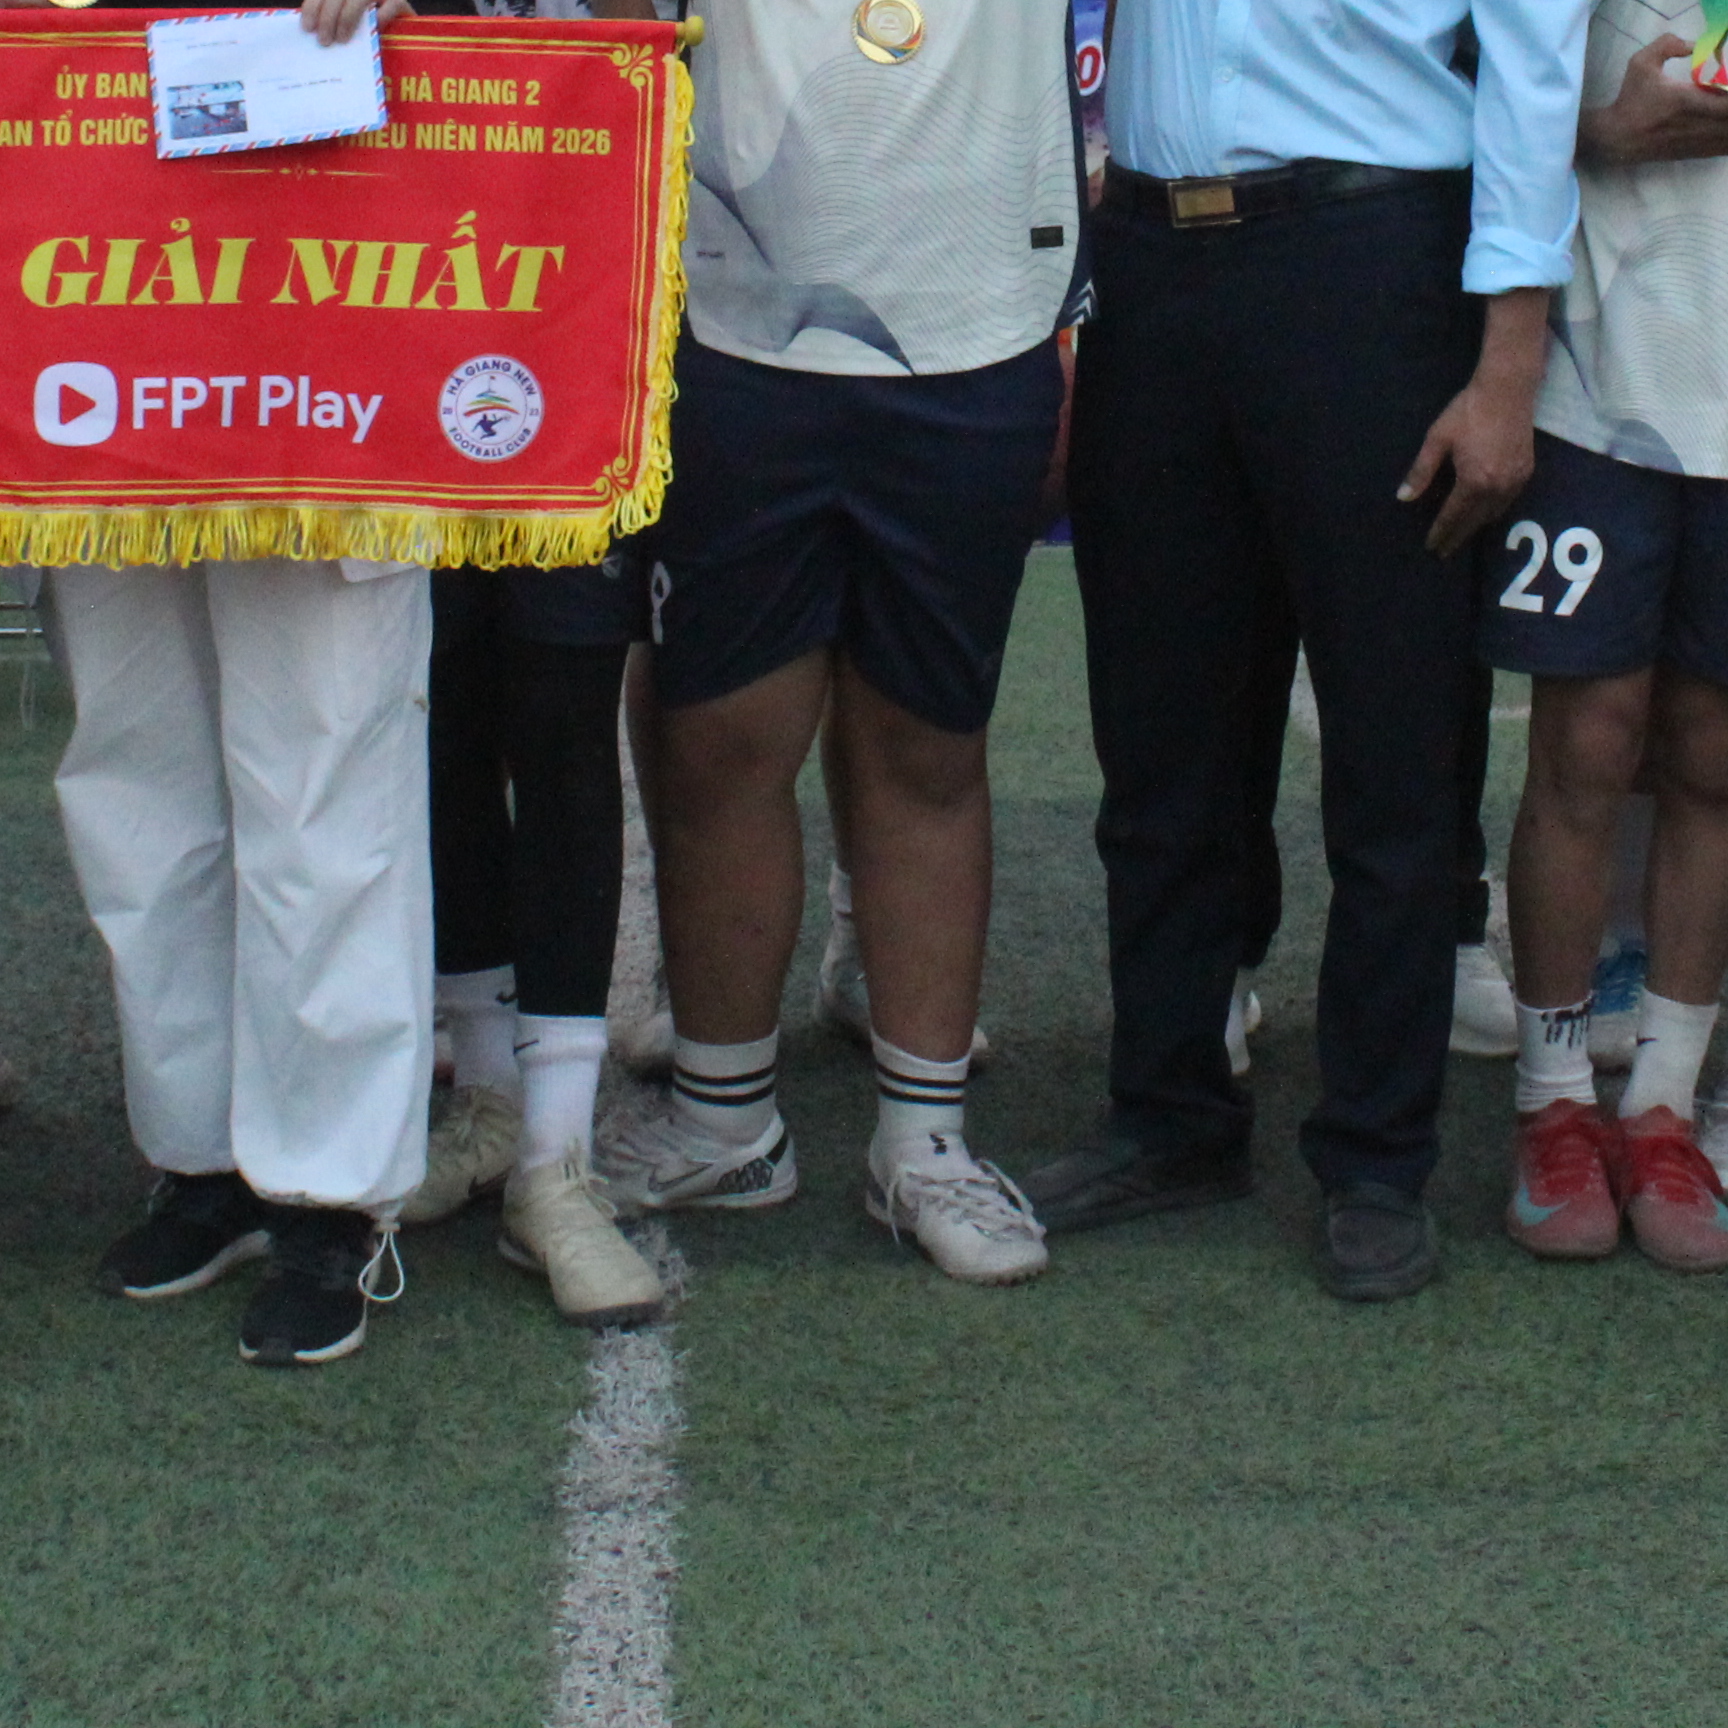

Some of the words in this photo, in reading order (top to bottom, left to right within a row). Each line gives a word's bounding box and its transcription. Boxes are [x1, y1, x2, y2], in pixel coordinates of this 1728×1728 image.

[56, 65, 89, 100] ỦY
[95, 72, 149, 99] BAN
[400, 71, 434, 102] HÀ
[441, 76, 518, 106] GIANG
[524, 80, 541, 107] 2
[40, 109, 73, 147] TỔ
[79, 113, 150, 146] CHỨC
[415, 119, 477, 151] NIÊN
[484, 121, 545, 153] NĂM
[551, 126, 612, 156] 2026
[21, 217, 256, 309] GIẢI
[269, 210, 565, 313] NHẤT
[514, 369, 537, 396] NEW
[132, 375, 246, 430] FPT
[257, 374, 383, 444] Play
[449, 427, 503, 457] FOOTBALL
[1499, 520, 1605, 617] 29
